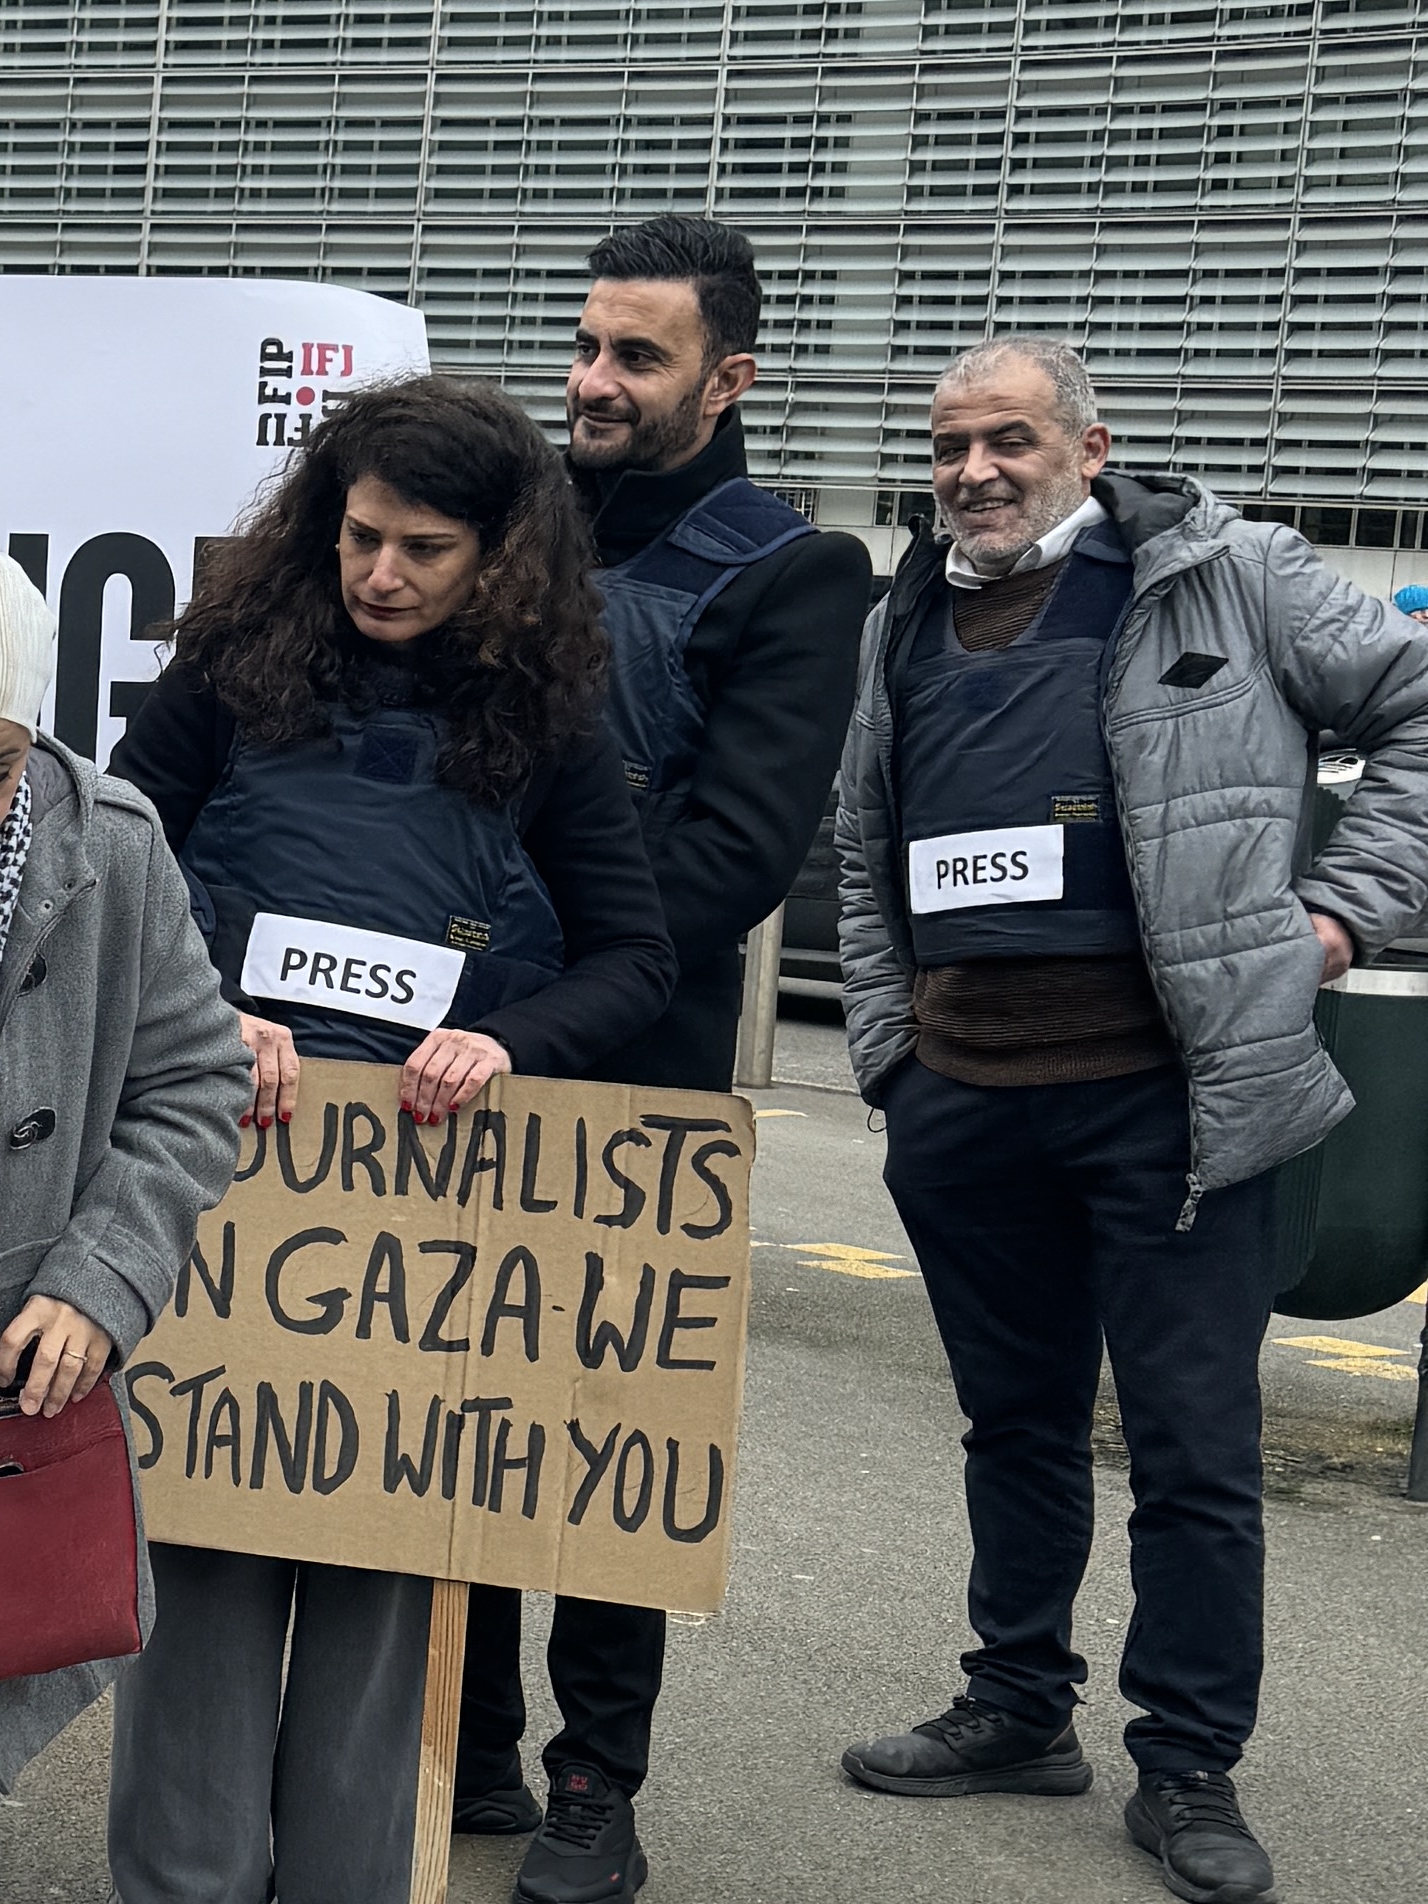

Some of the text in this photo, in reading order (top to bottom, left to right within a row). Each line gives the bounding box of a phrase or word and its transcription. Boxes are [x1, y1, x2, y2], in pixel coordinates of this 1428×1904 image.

[301, 342, 354, 377] IFJ
[936, 850, 1029, 889] PRESS
[280, 947, 417, 1004] PRESS
[575, 1251, 732, 1373] WE
[125, 1360, 724, 1546] STAND WITH YOU
